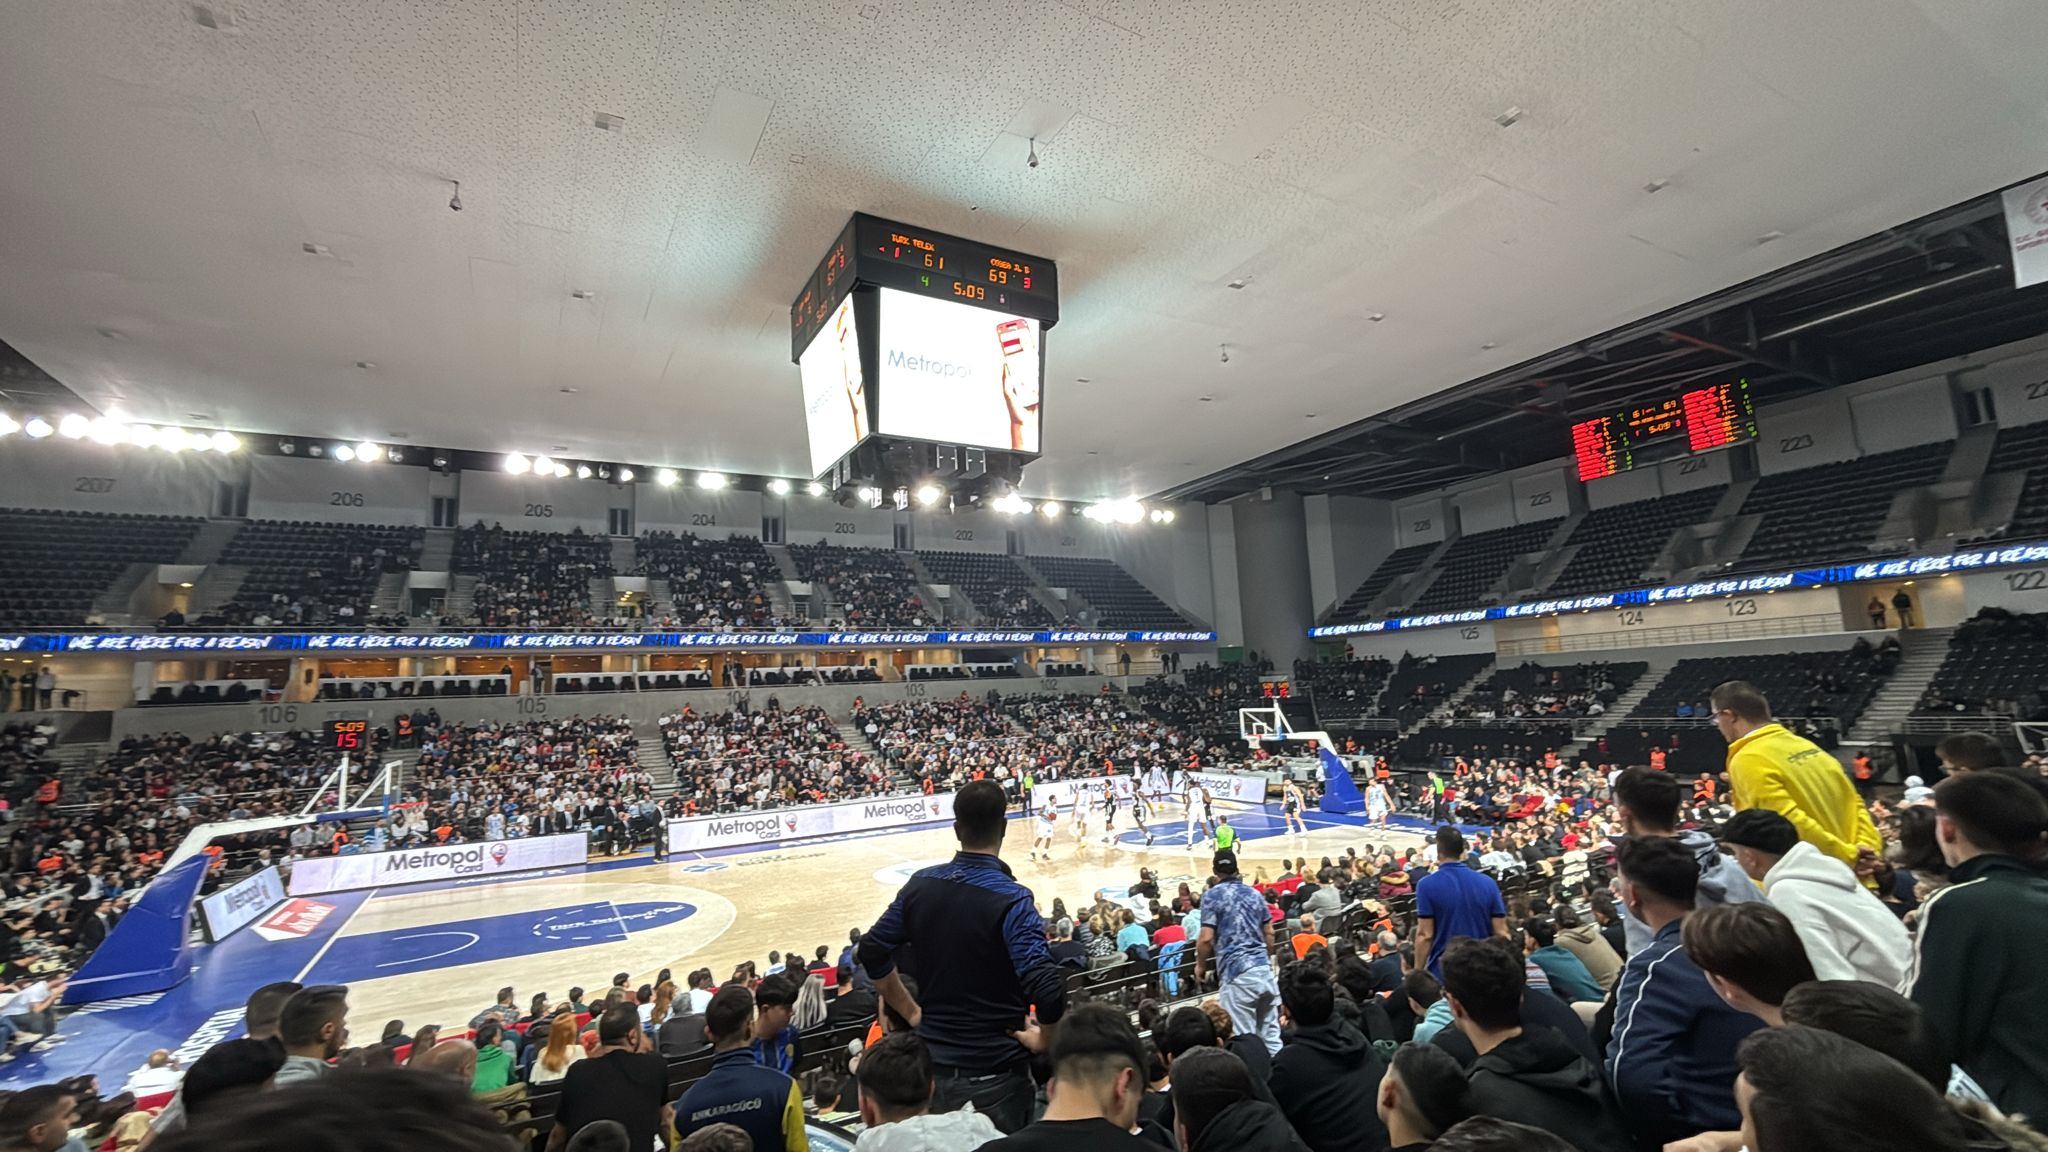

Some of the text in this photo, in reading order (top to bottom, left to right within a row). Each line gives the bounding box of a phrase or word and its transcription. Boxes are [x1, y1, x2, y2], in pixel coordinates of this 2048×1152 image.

[924, 253, 944, 270] 61
[921, 275, 929, 287] 4
[989, 269, 1007, 284] 69
[1024, 277, 1031, 289] 3
[1780, 434, 1814, 453] 223
[1679, 458, 1707, 475] 224
[330, 491, 364, 507] 206
[1529, 491, 1552, 507] 225
[524, 503, 553, 518] 205
[692, 514, 716, 526] 204
[834, 522, 856, 534] 203
[955, 530, 973, 541] 202
[1855, 565, 1879, 579] WE
[1880, 560, 1909, 575] ARE
[1910, 556, 1952, 573] HERE
[1952, 554, 1984, 567] FOR
[1648, 589, 1665, 600] WE
[1666, 586, 1687, 598] ARE
[1686, 583, 1716, 597] HERE
[1716, 582, 1738, 592] FOR
[1749, 574, 1793, 588] REASON
[1725, 599, 1757, 617] 123
[1617, 611, 1644, 626] 124
[68, 635, 99, 649] WE
[97, 636, 132, 649] ARE
[130, 635, 176, 650] HERE
[174, 636, 204, 648] FOR
[218, 636, 272, 649] REASON
[309, 636, 331, 648] WE
[332, 636, 360, 647] ARE
[359, 635, 398, 648] HERE
[394, 636, 418, 647] FOR
[429, 636, 473, 648] REASON
[504, 635, 523, 646] WE
[523, 635, 546, 646] ARE
[545, 634, 577, 647] HERE
[576, 635, 597, 645] FOR
[605, 635, 643, 646] REASON
[905, 684, 925, 697] 103
[516, 697, 547, 714] 105
[259, 705, 297, 724] 106
[336, 733, 358, 747] 15
[864, 800, 926, 820] Metropol
[907, 812, 927, 821] Card
[707, 815, 780, 837] Metropol
[759, 829, 781, 840] Card
[386, 845, 484, 871] Metropol
[454, 862, 483, 874] Card
[691, 1097, 762, 1122] ANKARAGÜCÜ
